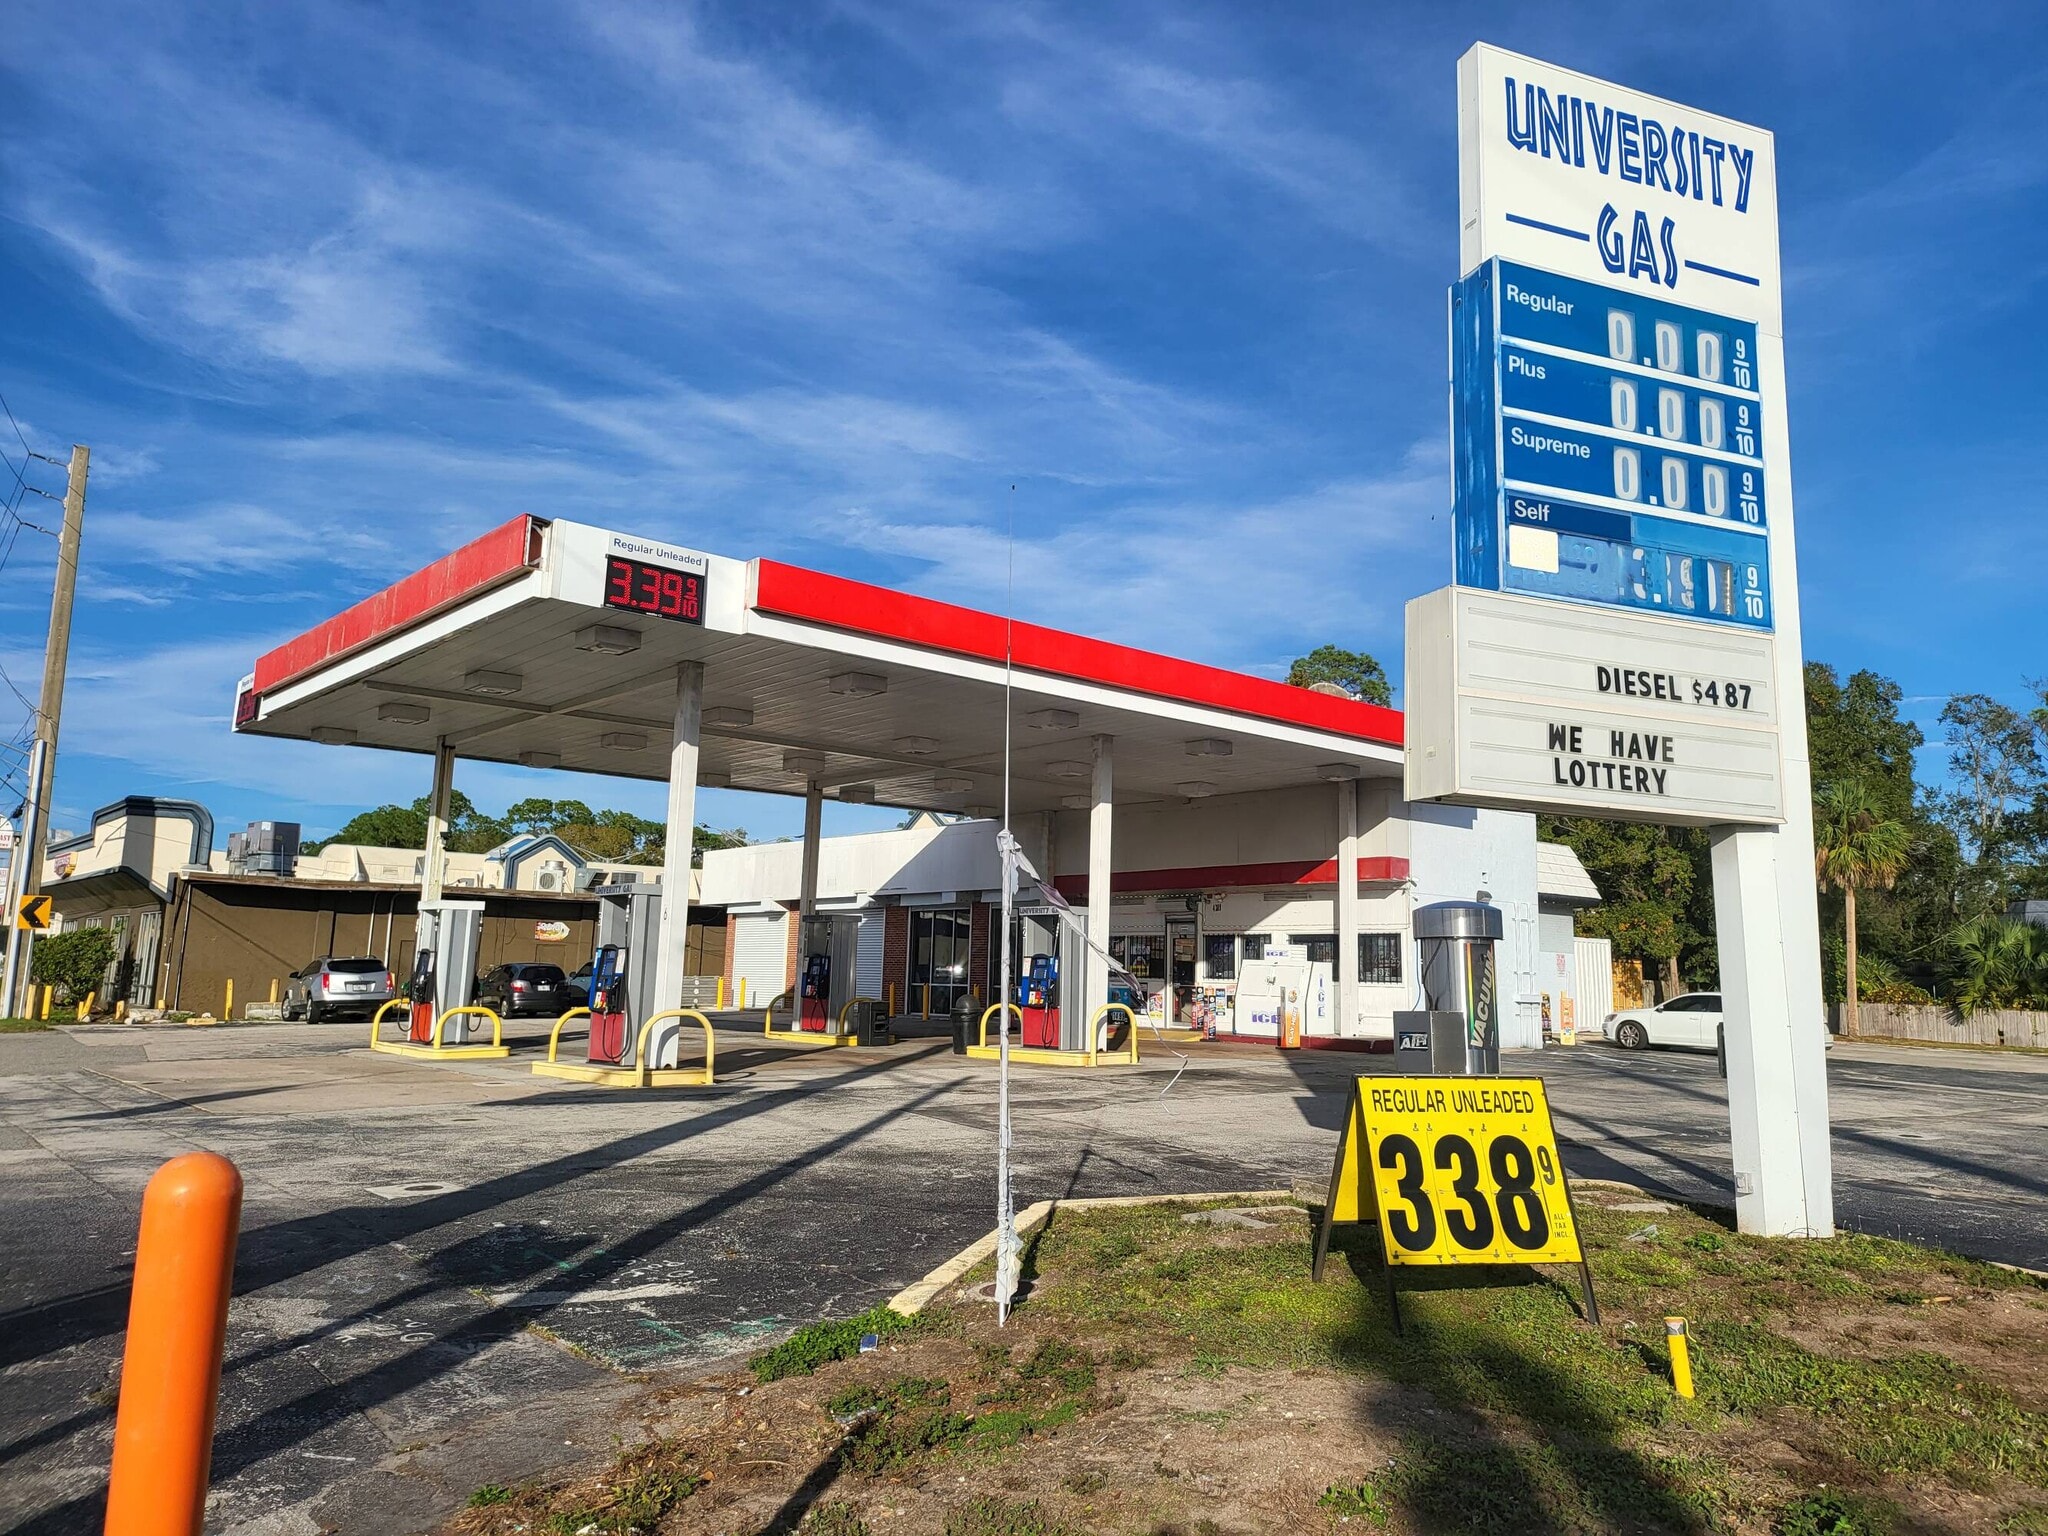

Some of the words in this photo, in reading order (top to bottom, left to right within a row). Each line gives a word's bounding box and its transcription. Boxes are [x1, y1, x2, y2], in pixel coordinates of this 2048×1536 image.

[1504, 77, 1753, 214] UNIVERSITY
[1597, 202, 1678, 290] GAS
[1506, 285, 1574, 317] Regular
[1508, 355, 1546, 381] Plus
[1511, 427, 1591, 460] Supreme
[1514, 500, 1550, 522] Self
[614, 538, 654, 555] Regular
[656, 549, 702, 566] Unleaded
[609, 561, 682, 615] 3.39
[1597, 666, 1682, 701] DIESEL
[1549, 723, 1583, 754] WE
[1611, 731, 1674, 763] HAVE
[1554, 758, 1667, 794] LOTTERY
[1471, 950, 1494, 1047] VACUUM
[1372, 1089, 1447, 1113] REGULAR
[1451, 1089, 1534, 1113] UNLEADED
[1378, 1134, 1549, 1252] 338
